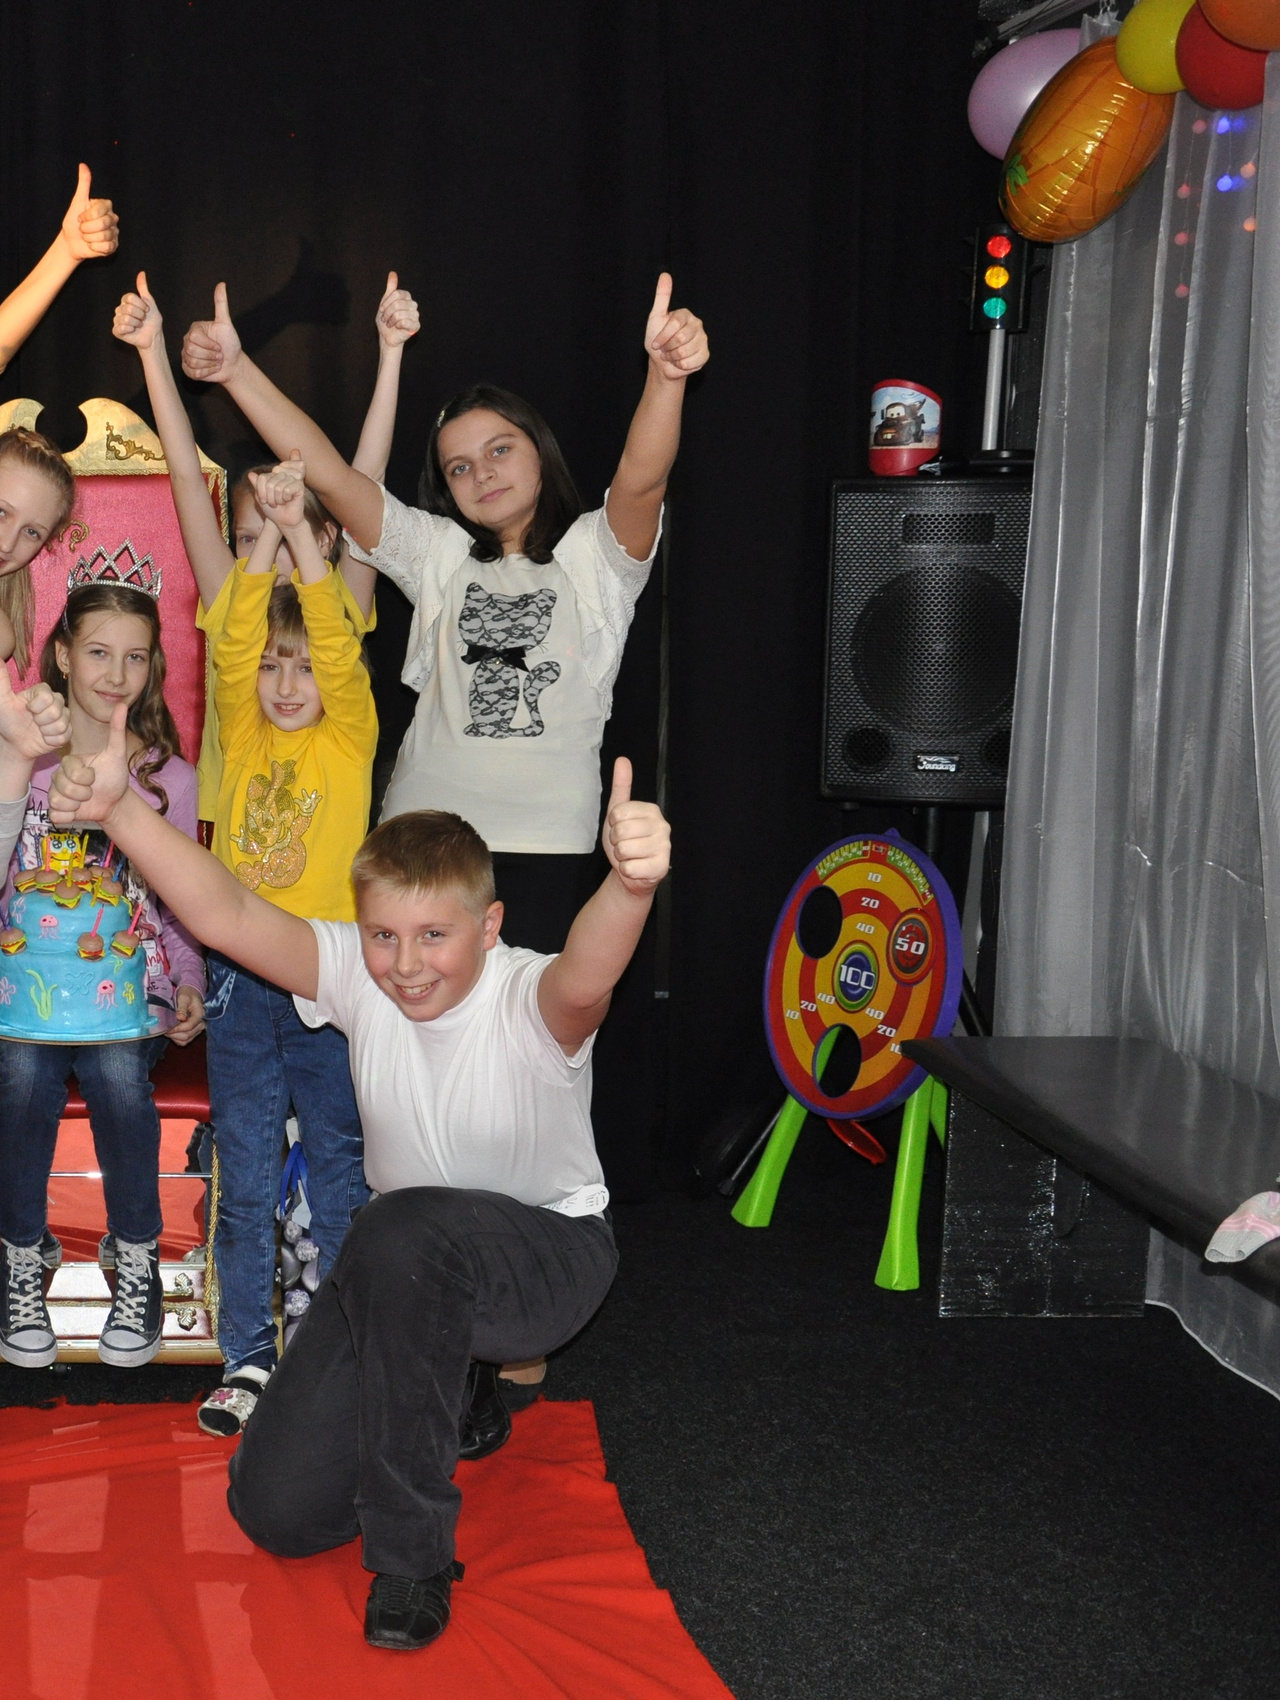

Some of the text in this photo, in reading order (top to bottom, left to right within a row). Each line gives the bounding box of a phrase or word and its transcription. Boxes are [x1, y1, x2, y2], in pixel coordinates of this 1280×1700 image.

[867, 871, 882, 883] 10
[861, 896, 880, 909] 20
[856, 922, 875, 934] 40
[895, 937, 925, 955] 50
[840, 964, 875, 990] 100
[817, 992, 836, 1005] 40
[800, 1000, 817, 1013] 20
[785, 1009, 800, 1021] 10
[865, 1007, 885, 1020] 40
[877, 1024, 897, 1038] 20
